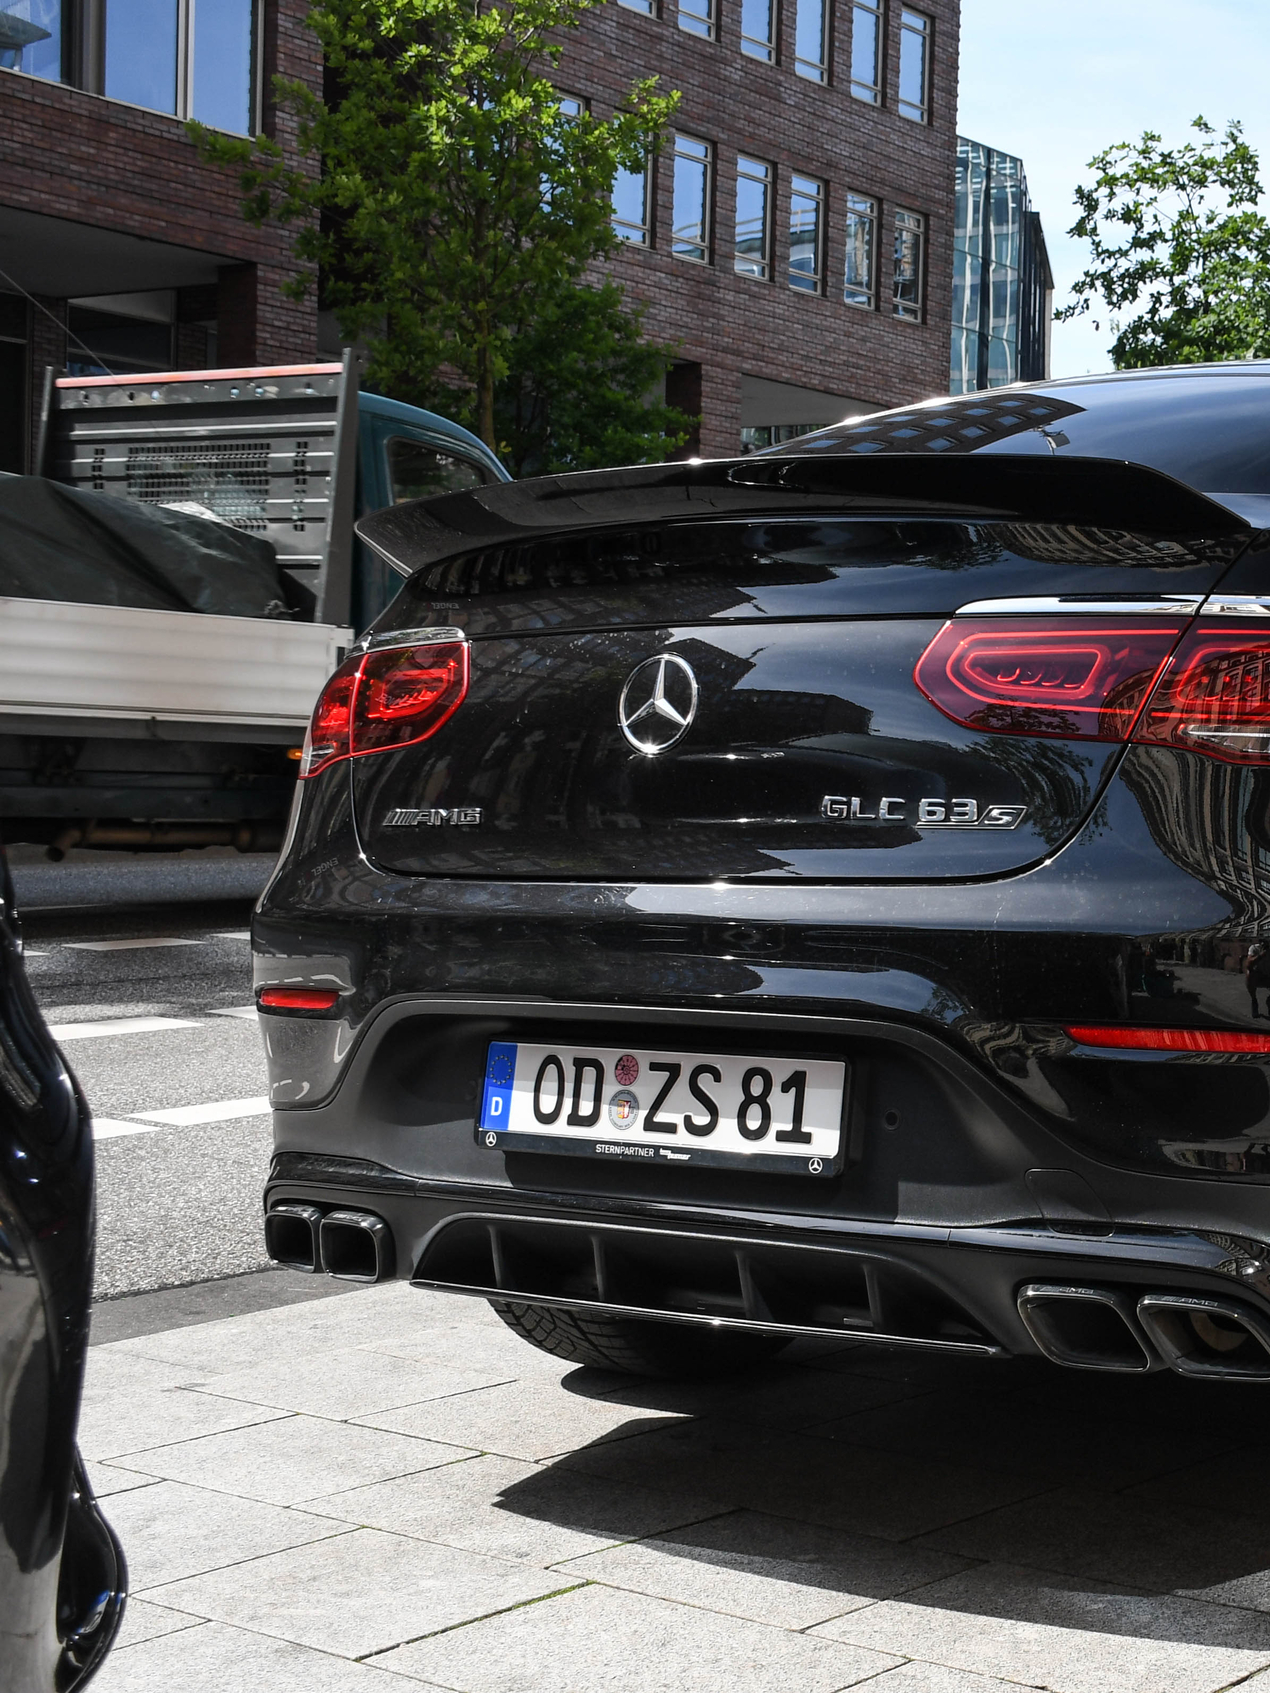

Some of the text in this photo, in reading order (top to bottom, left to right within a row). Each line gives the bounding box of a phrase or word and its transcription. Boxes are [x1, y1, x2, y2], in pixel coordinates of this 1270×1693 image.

[410, 808, 482, 826] AMG
[821, 795, 906, 820] GLC
[490, 1096, 503, 1117] D
[533, 1054, 605, 1128] OD
[643, 1062, 722, 1137] ZS
[737, 1066, 812, 1144] 81
[595, 1143, 655, 1158] STERNPARTNER
